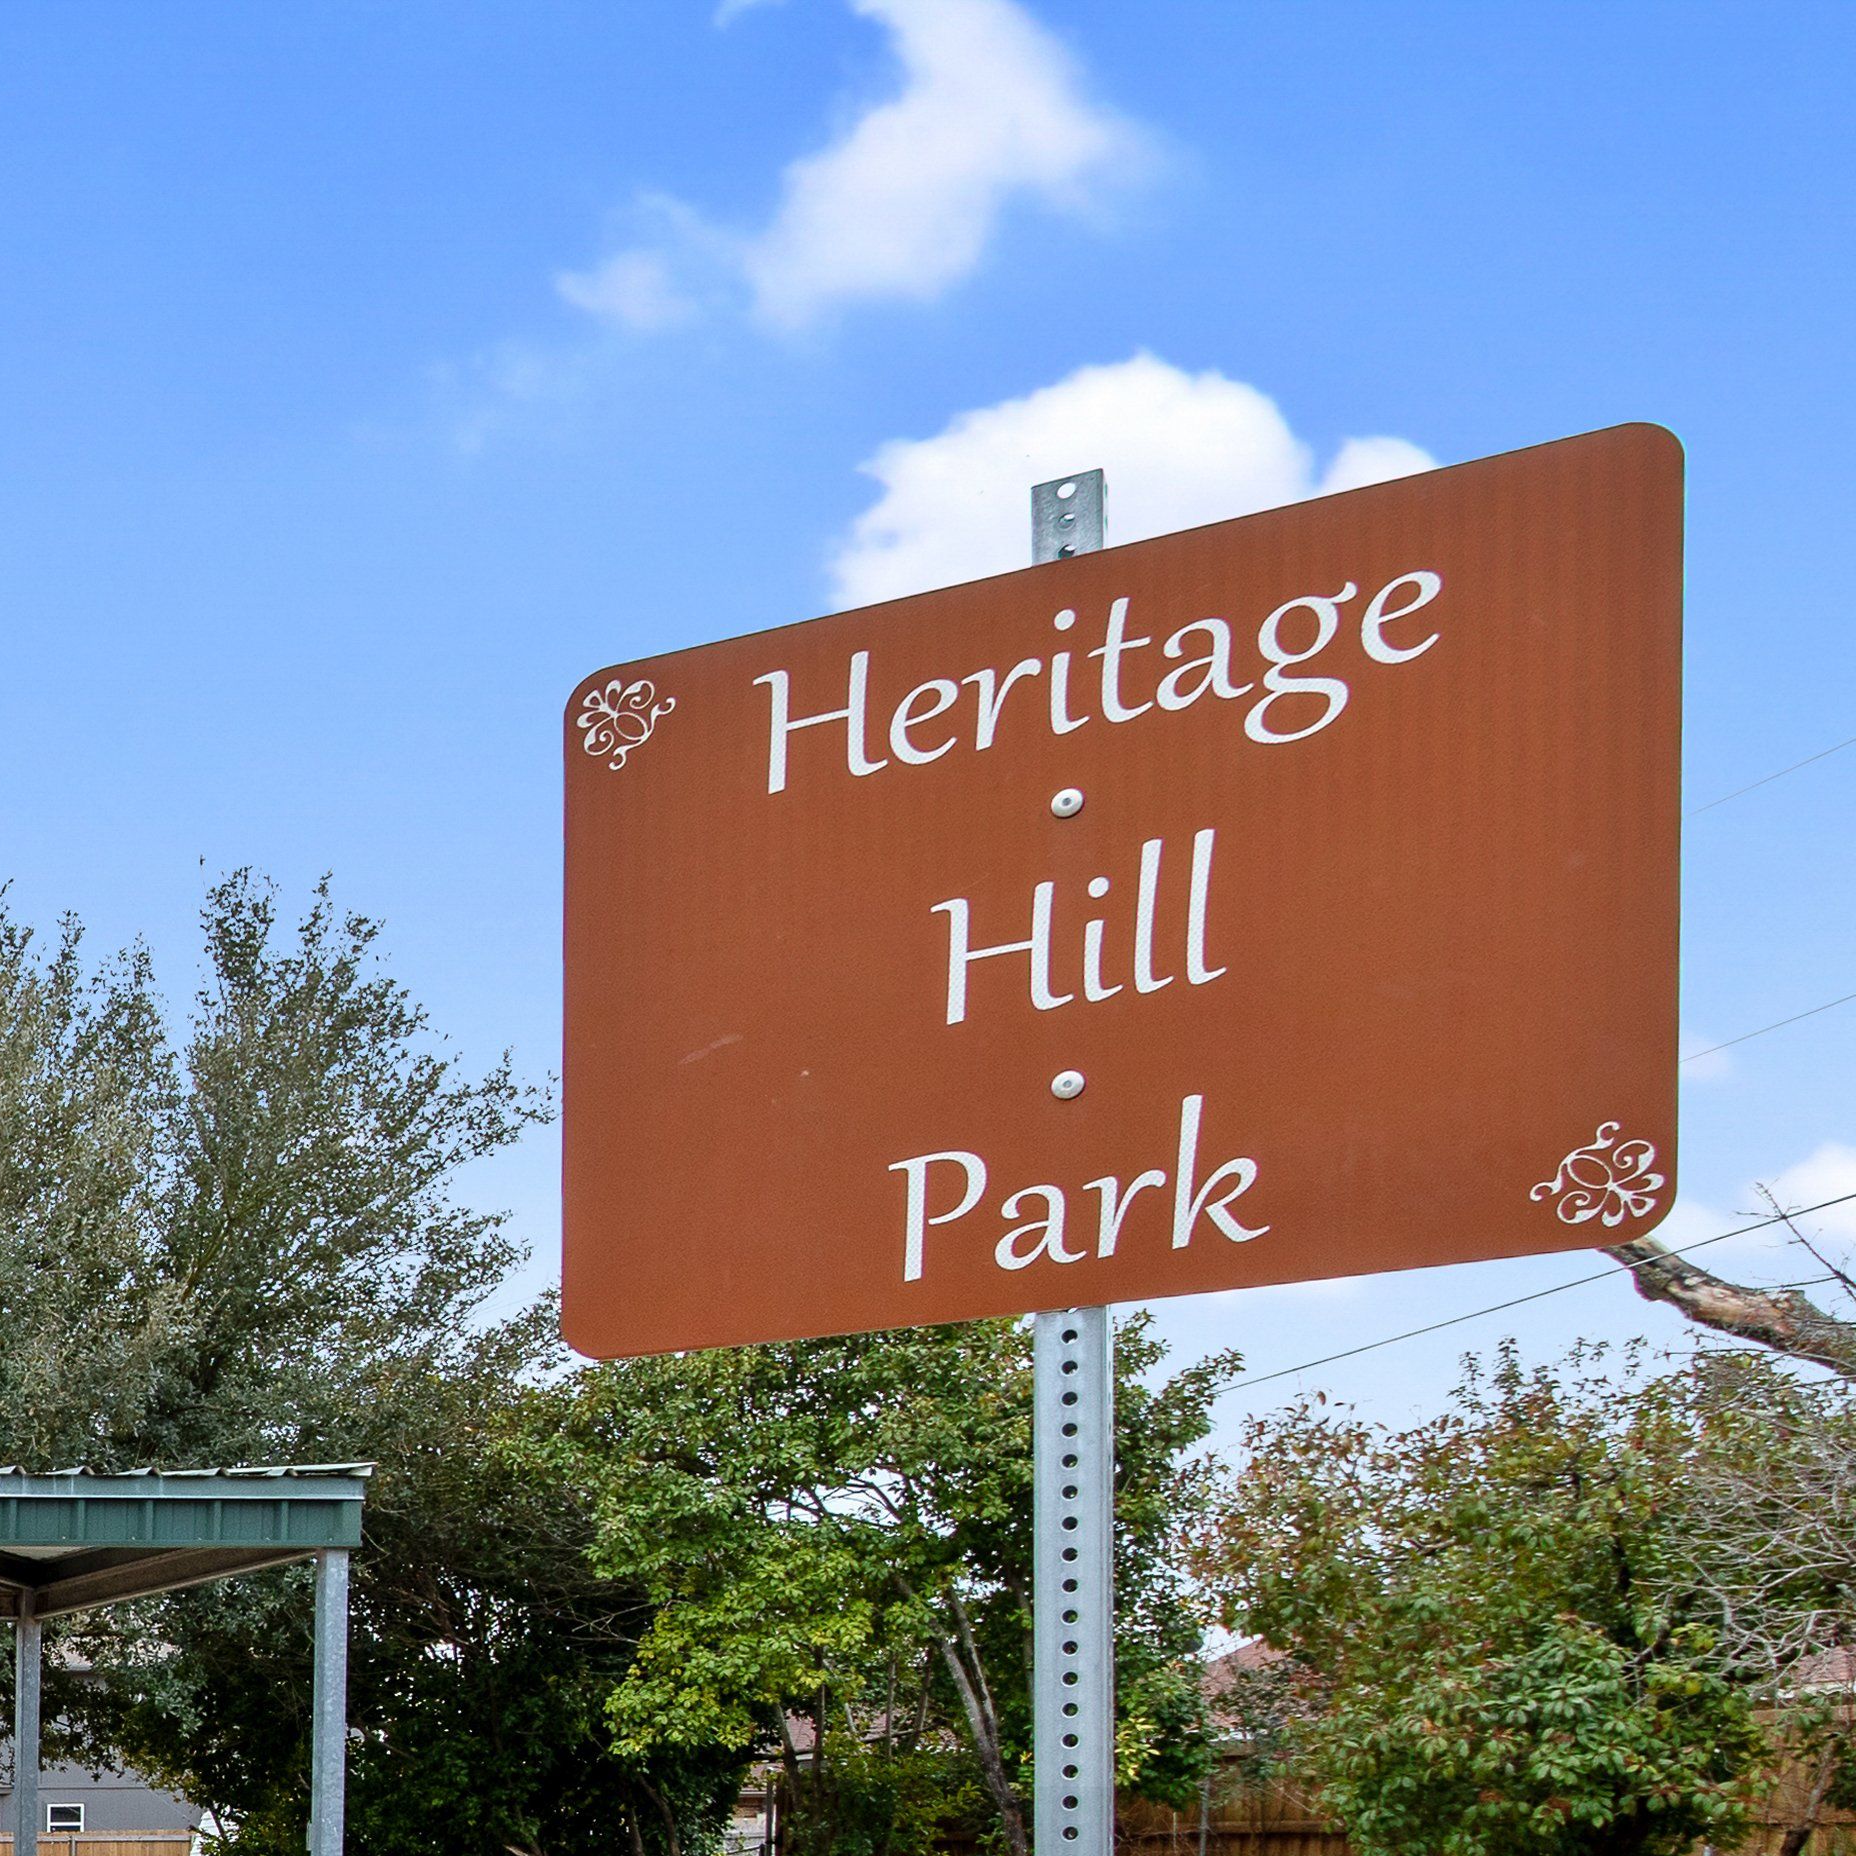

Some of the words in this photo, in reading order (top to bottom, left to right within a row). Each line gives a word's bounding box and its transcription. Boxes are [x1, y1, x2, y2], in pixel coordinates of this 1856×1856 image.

[753, 569, 1443, 795] Heritage
[930, 827, 1227, 1025] Hill
[888, 1093, 1270, 1283] Park
